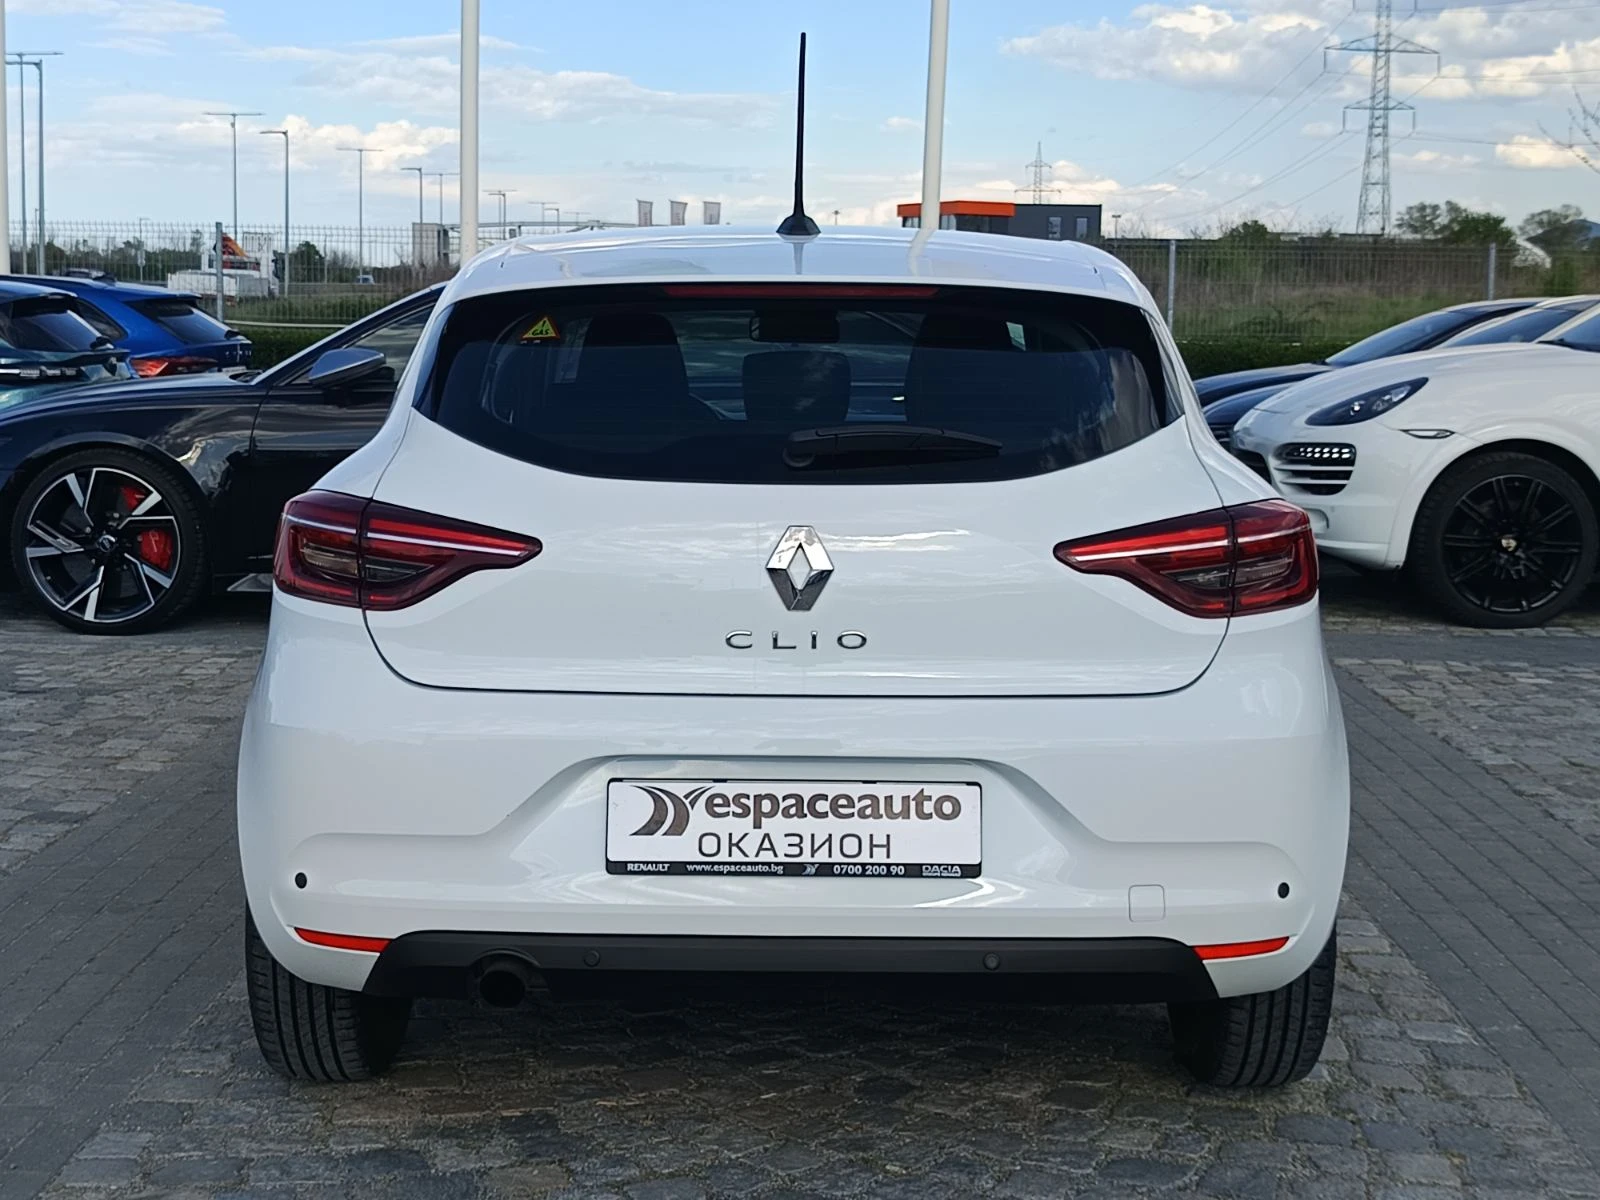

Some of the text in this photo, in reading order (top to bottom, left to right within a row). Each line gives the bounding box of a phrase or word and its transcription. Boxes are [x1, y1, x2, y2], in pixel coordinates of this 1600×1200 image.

[531, 328, 549, 336] GAS
[725, 630, 867, 650] CLIO
[705, 788, 962, 829] espaceauto
[698, 832, 891, 859] ОКАЗИОН
[627, 863, 961, 876] RENAULT www.espaceauto.bg 0700 200 90 DACIA
